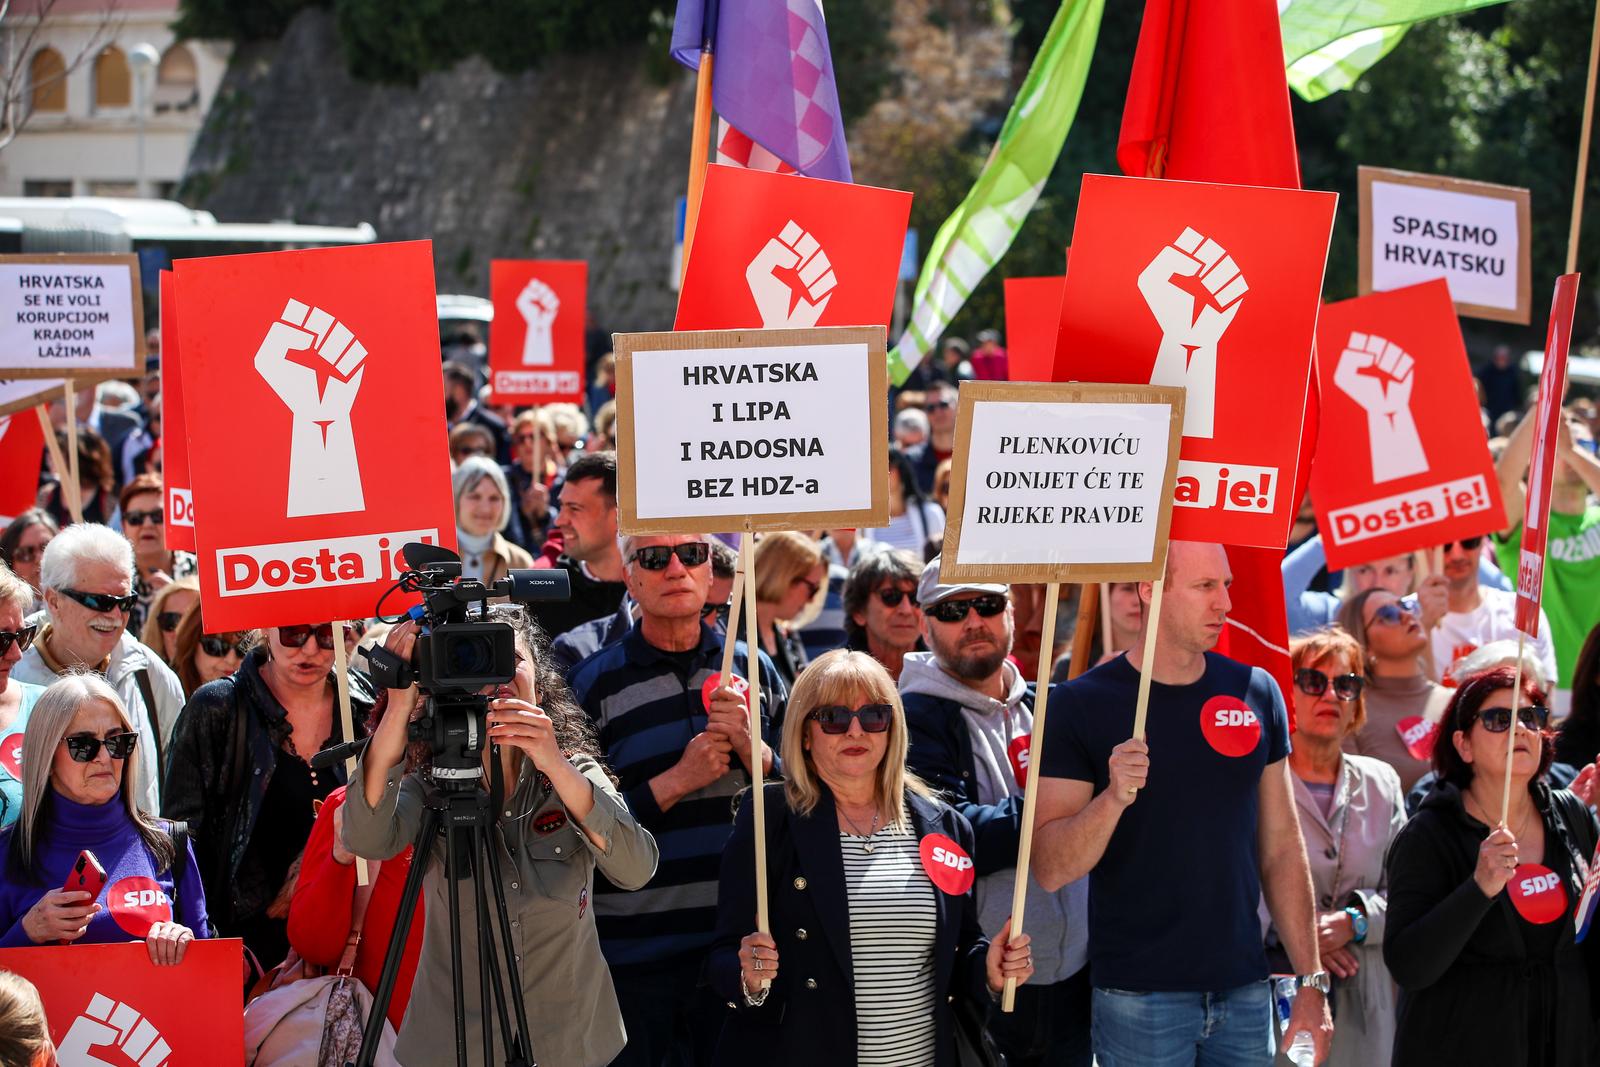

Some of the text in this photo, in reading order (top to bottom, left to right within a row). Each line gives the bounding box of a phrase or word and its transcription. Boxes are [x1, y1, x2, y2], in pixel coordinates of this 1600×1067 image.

[1392, 216, 1497, 246] SPASIMO
[1384, 243, 1505, 276] HRVATSKU
[19, 275, 105, 289] HRVATSKA
[24, 294, 101, 306] SE NE VOLI
[17, 312, 109, 323] KORUPCIJOM
[38, 343, 92, 358] LAŽIMA
[683, 362, 819, 386] HRVATSKA
[712, 401, 791, 423] I LIPA
[681, 437, 825, 461] I RADOSNA
[998, 432, 1141, 456] PLENKOVIĆU
[687, 475, 819, 499] BEZ HDZ-a
[985, 466, 1144, 489] ODNIJET ĆE TE
[1209, 467, 1272, 510] je!
[977, 506, 1144, 524] RIJEKE PRAVDE
[1335, 481, 1485, 540] Dosta je!
[223, 548, 365, 592] Dosta
[371, 657, 389, 671] SONY
[1215, 709, 1257, 727] SDP
[932, 846, 973, 872] SDP
[1521, 872, 1560, 897] SDP
[124, 889, 167, 907] SDP
